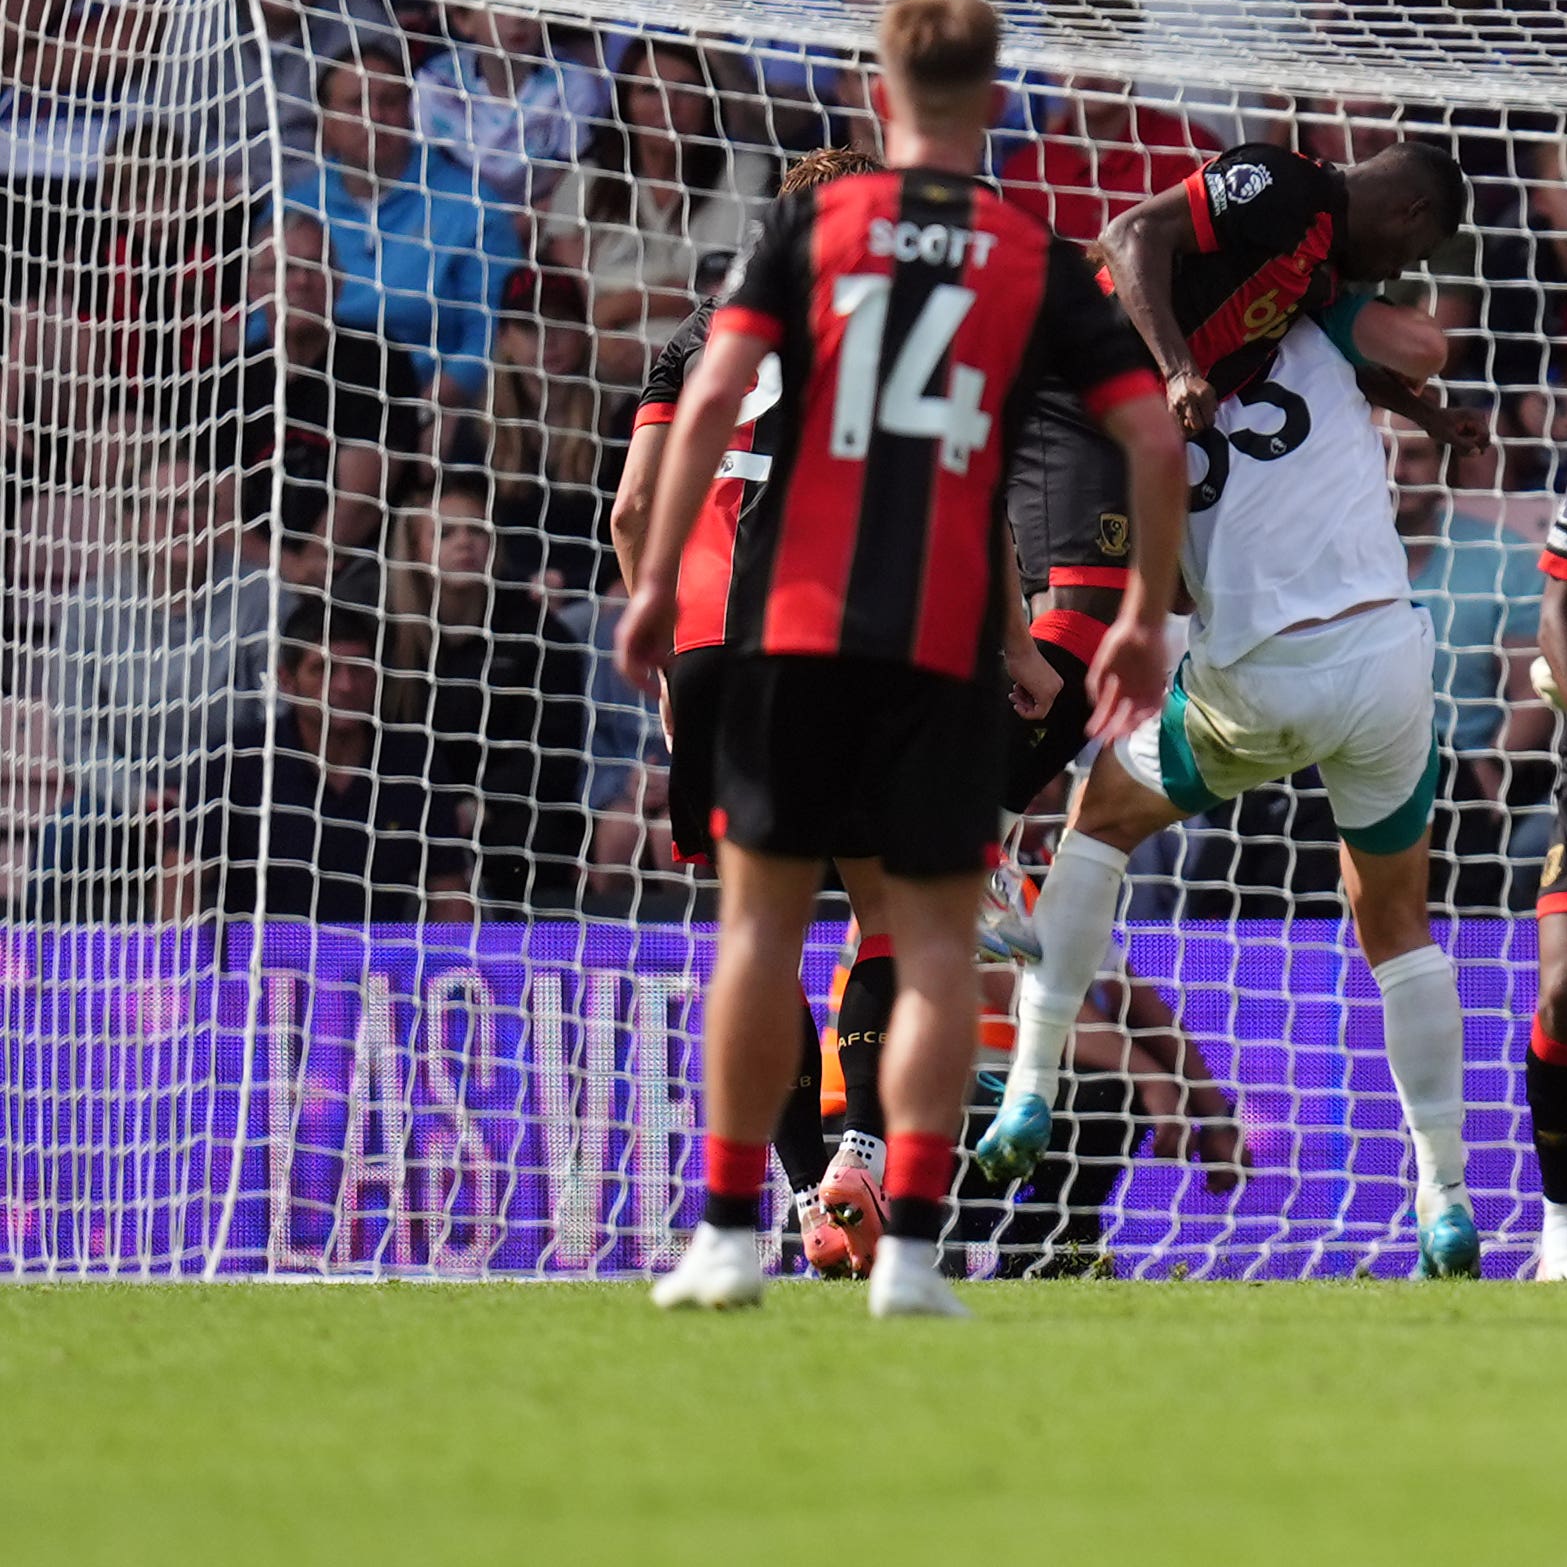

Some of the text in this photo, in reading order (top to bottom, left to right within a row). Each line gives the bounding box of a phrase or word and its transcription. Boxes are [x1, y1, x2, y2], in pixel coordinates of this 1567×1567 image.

[868, 217, 998, 269] SCOTT
[829, 273, 992, 477] 14
[268, 966, 498, 1269] LAS
